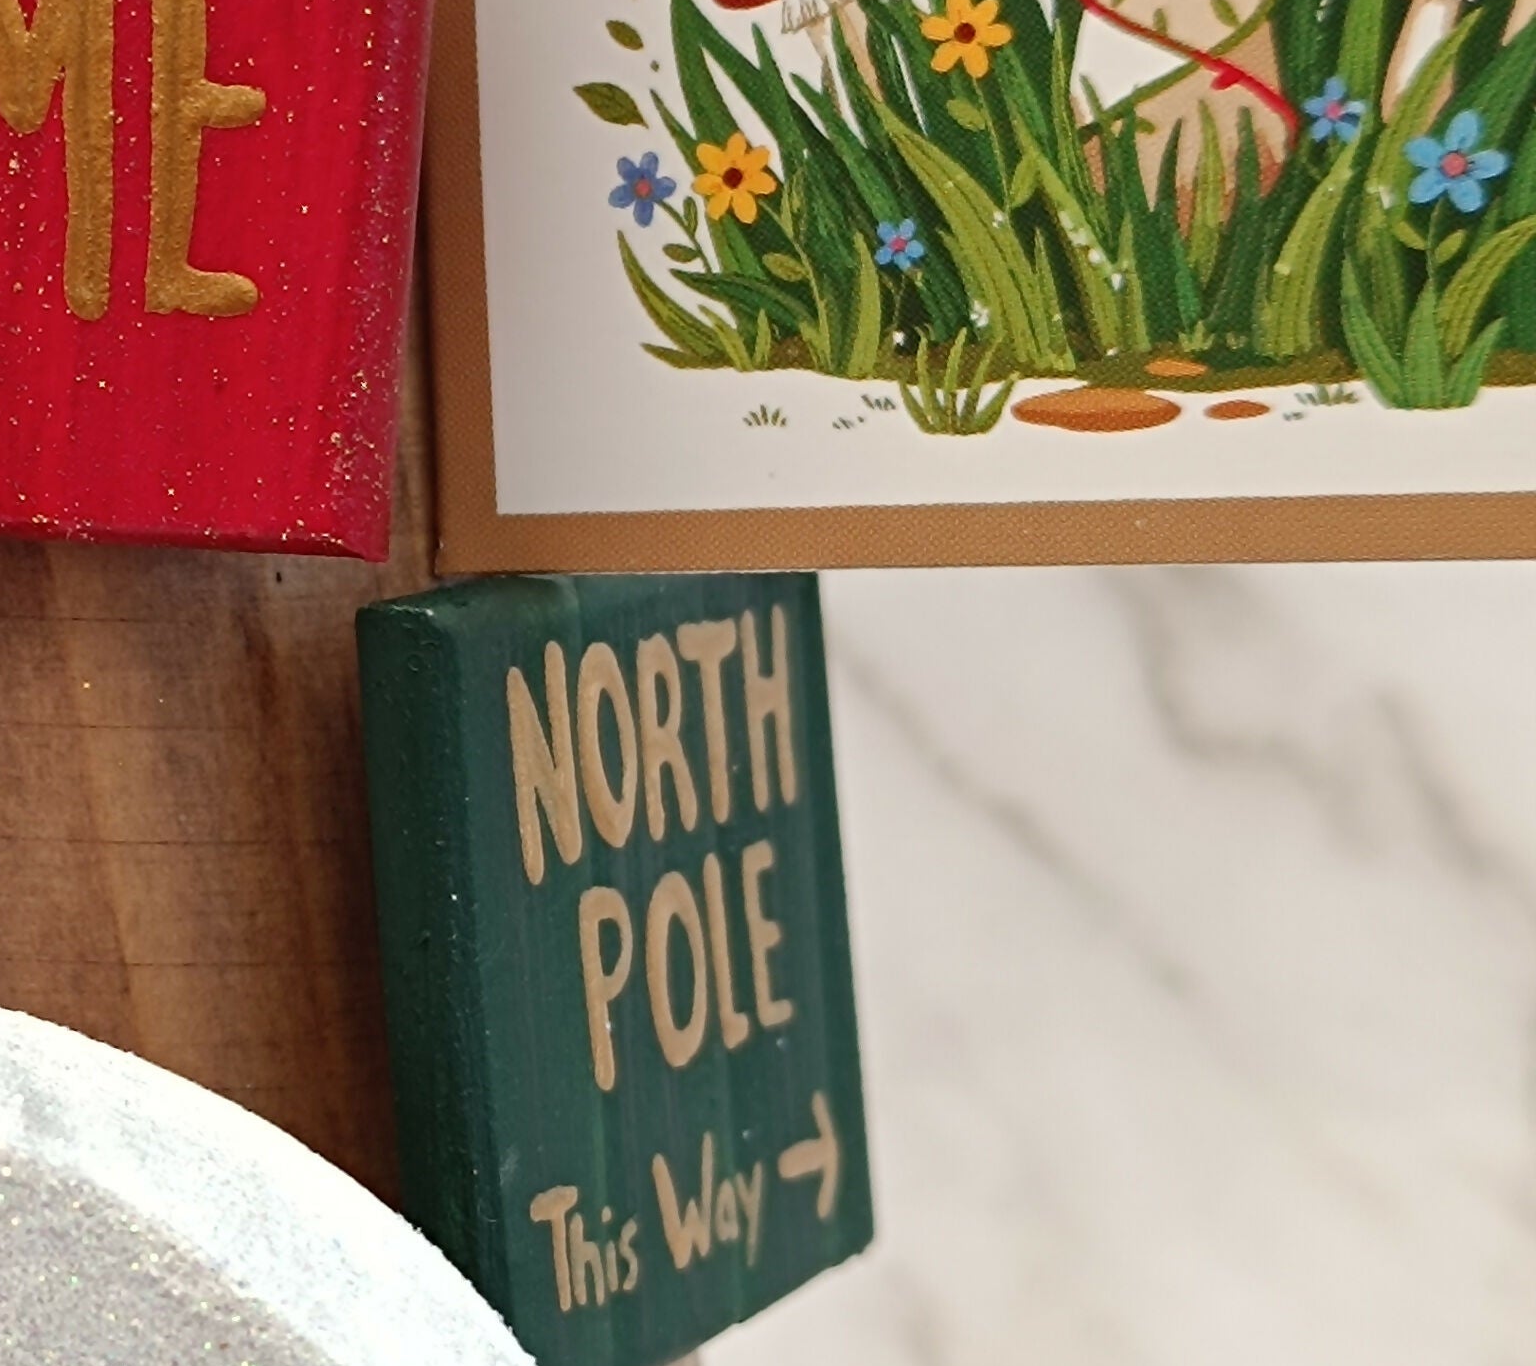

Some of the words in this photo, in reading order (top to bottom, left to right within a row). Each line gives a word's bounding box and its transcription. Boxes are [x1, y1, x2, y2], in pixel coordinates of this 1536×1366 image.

[506, 604, 797, 885] NORTH
[578, 839, 794, 1092] POLE
[530, 1184, 639, 1313] This
[652, 1130, 765, 1270] Way
